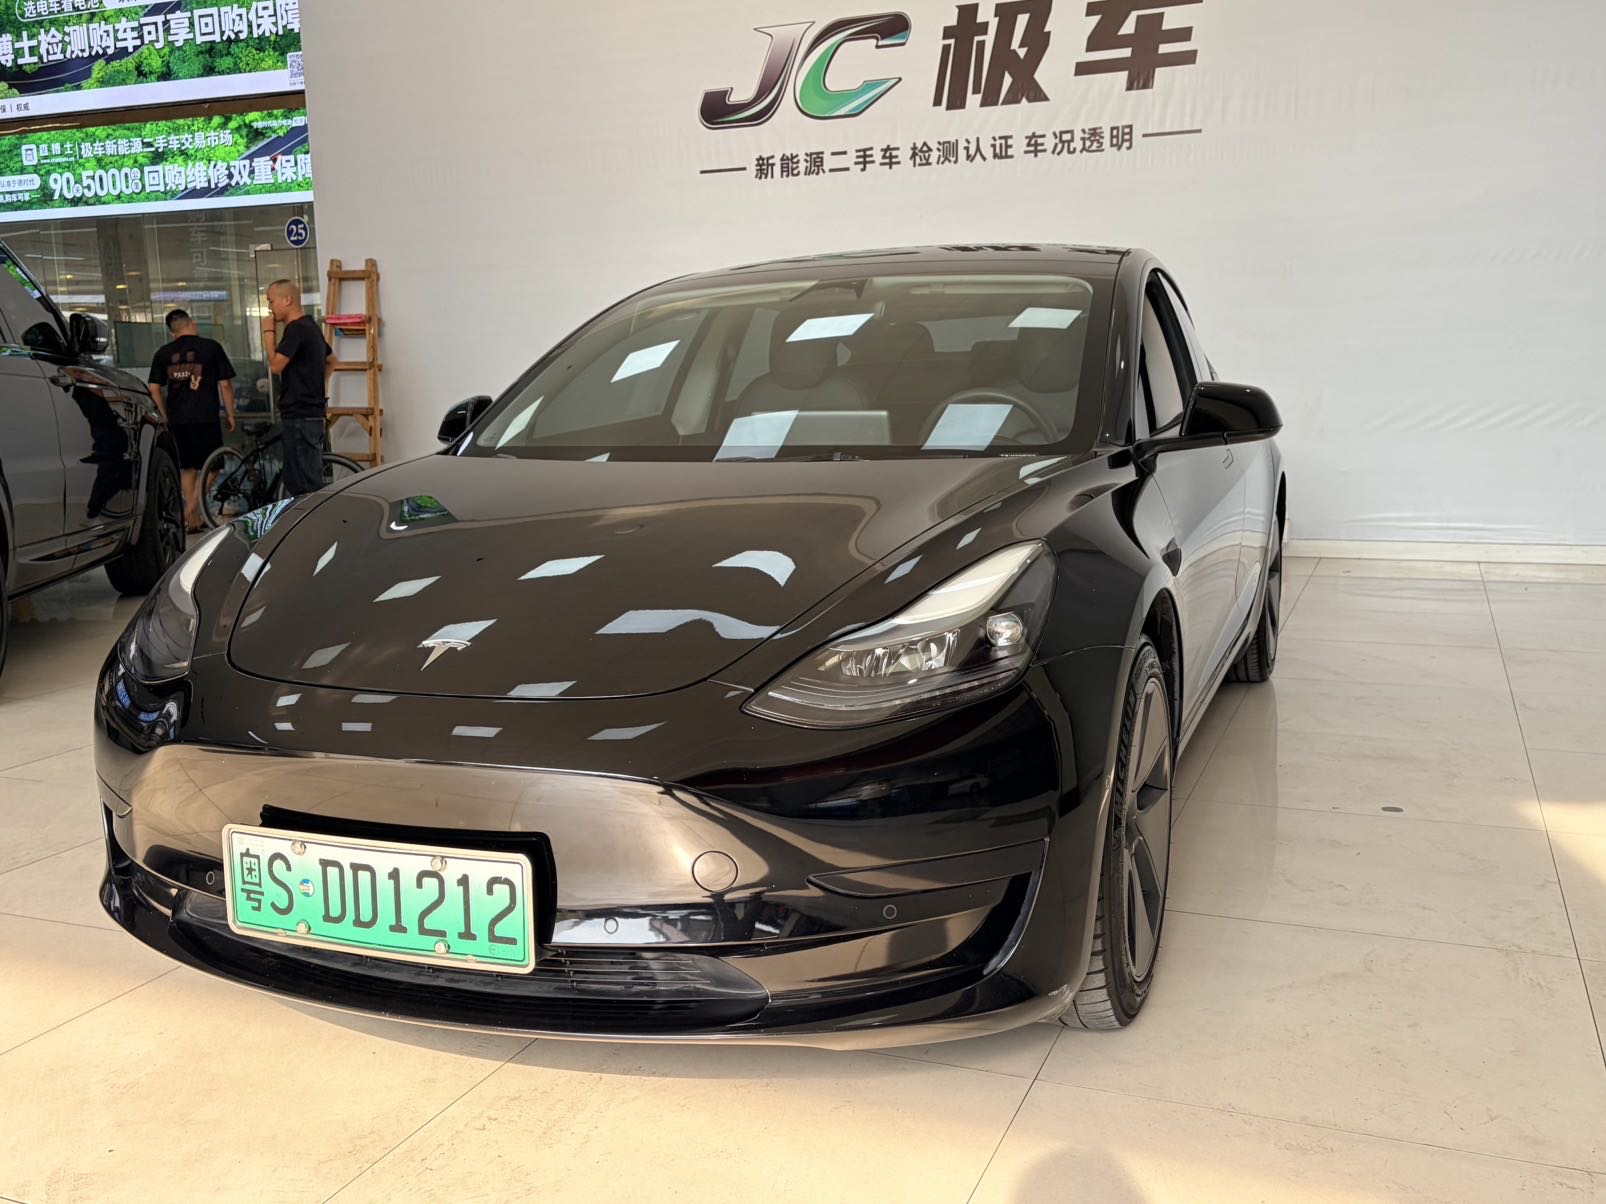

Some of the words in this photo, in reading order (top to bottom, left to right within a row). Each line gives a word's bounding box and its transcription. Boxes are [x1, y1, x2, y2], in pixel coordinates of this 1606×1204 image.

[698, 12, 911, 130] JC
[932, 0, 1201, 111] 极车
[754, 144, 902, 180] 新能源二手车
[909, 135, 1014, 168] 检测认证
[1024, 124, 1134, 158] 车况透明
[289, 223, 306, 241] 25
